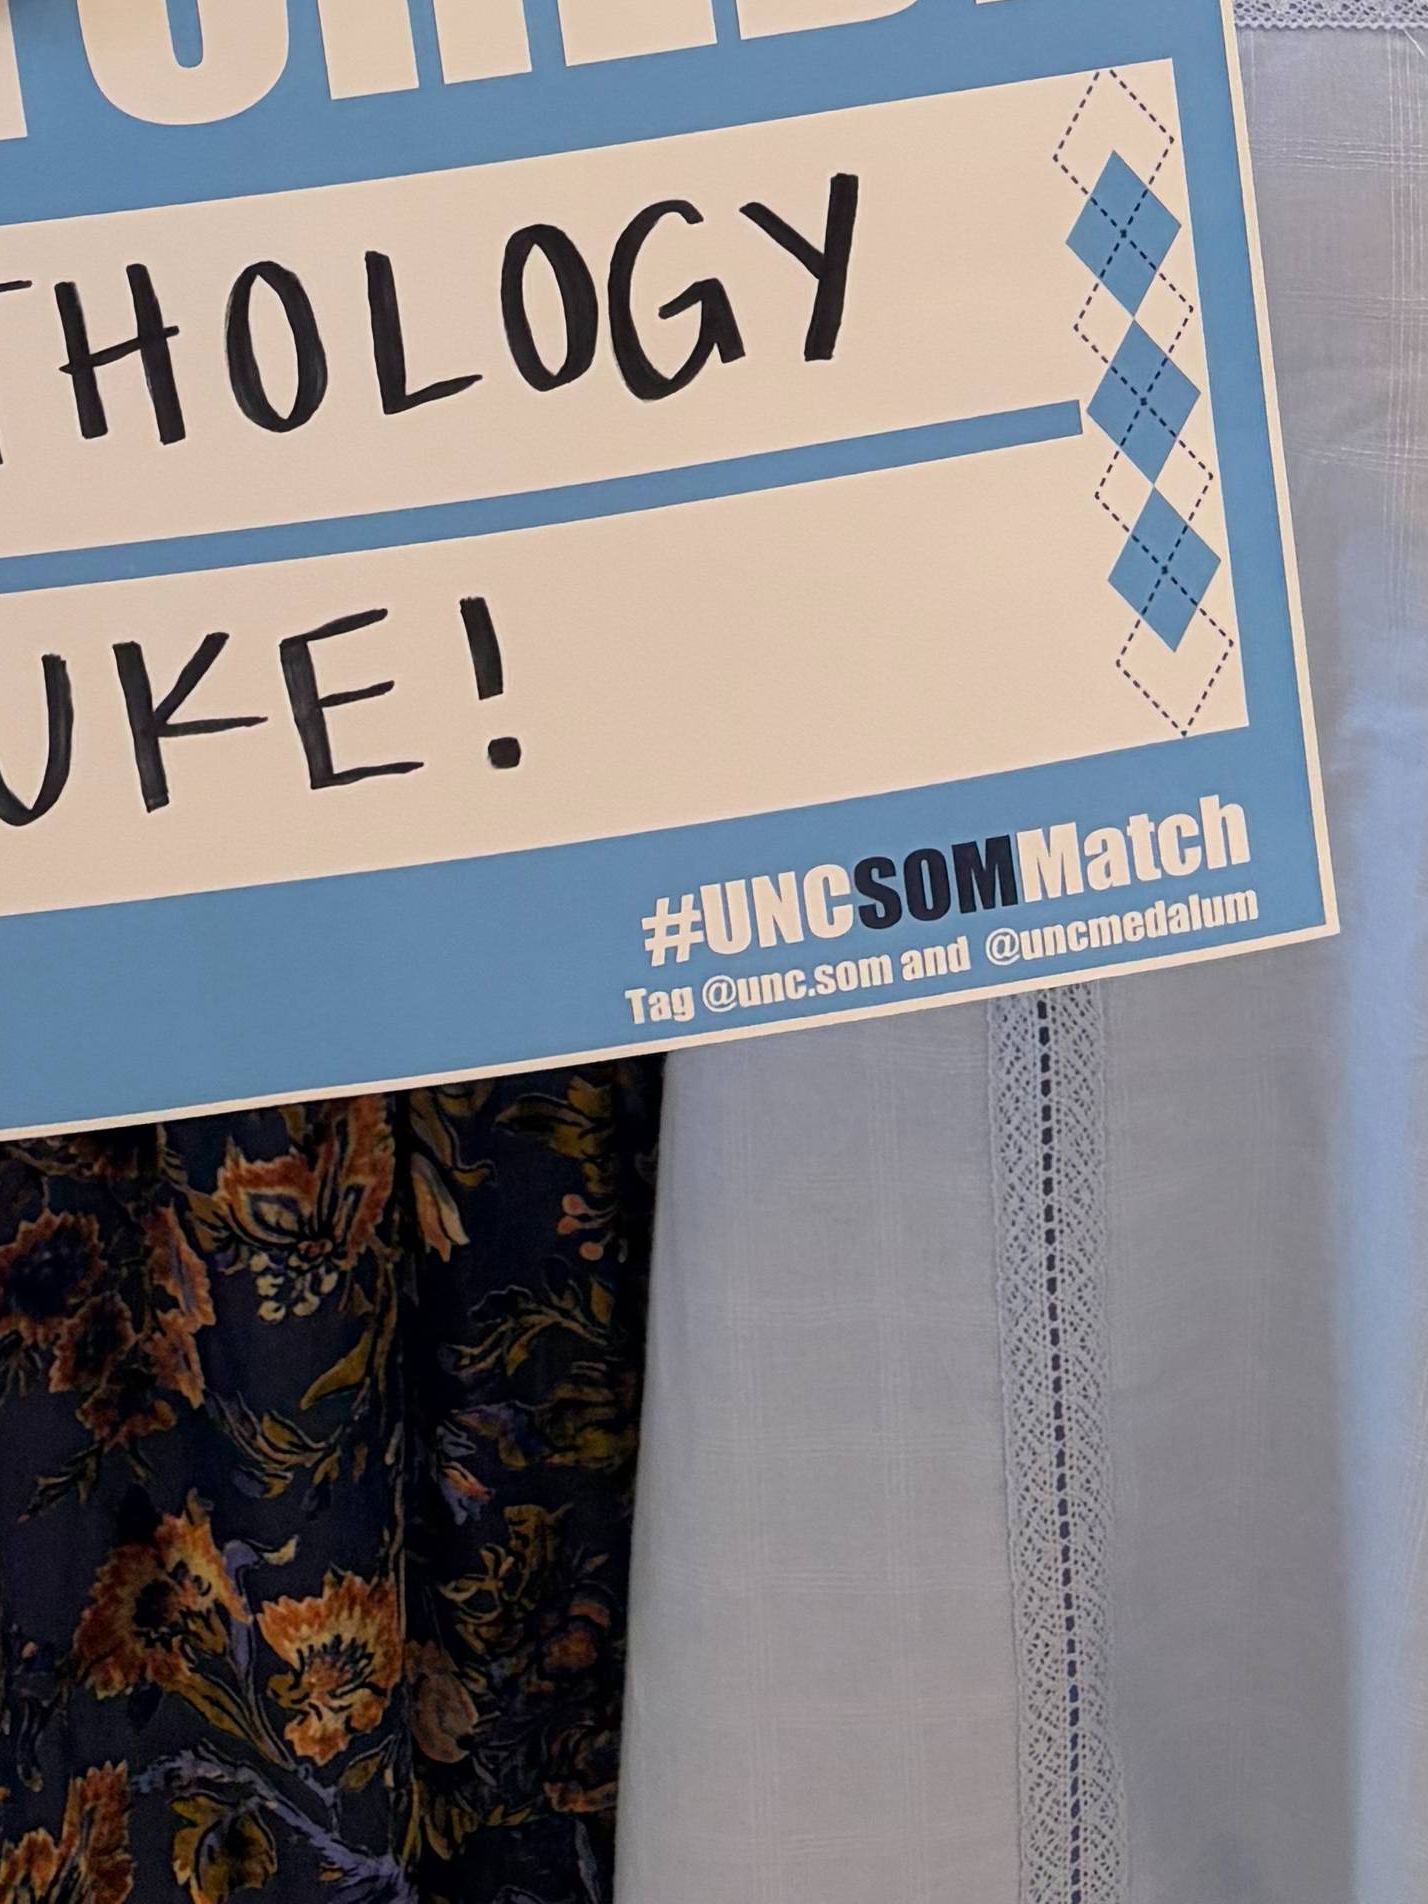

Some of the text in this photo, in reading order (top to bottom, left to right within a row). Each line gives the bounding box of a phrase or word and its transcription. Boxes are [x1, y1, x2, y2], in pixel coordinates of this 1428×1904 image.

[625, 889, 1259, 1025] Tag @unc.som and @uncmedalum
[642, 794, 1250, 966] #UNCSOMMatch
